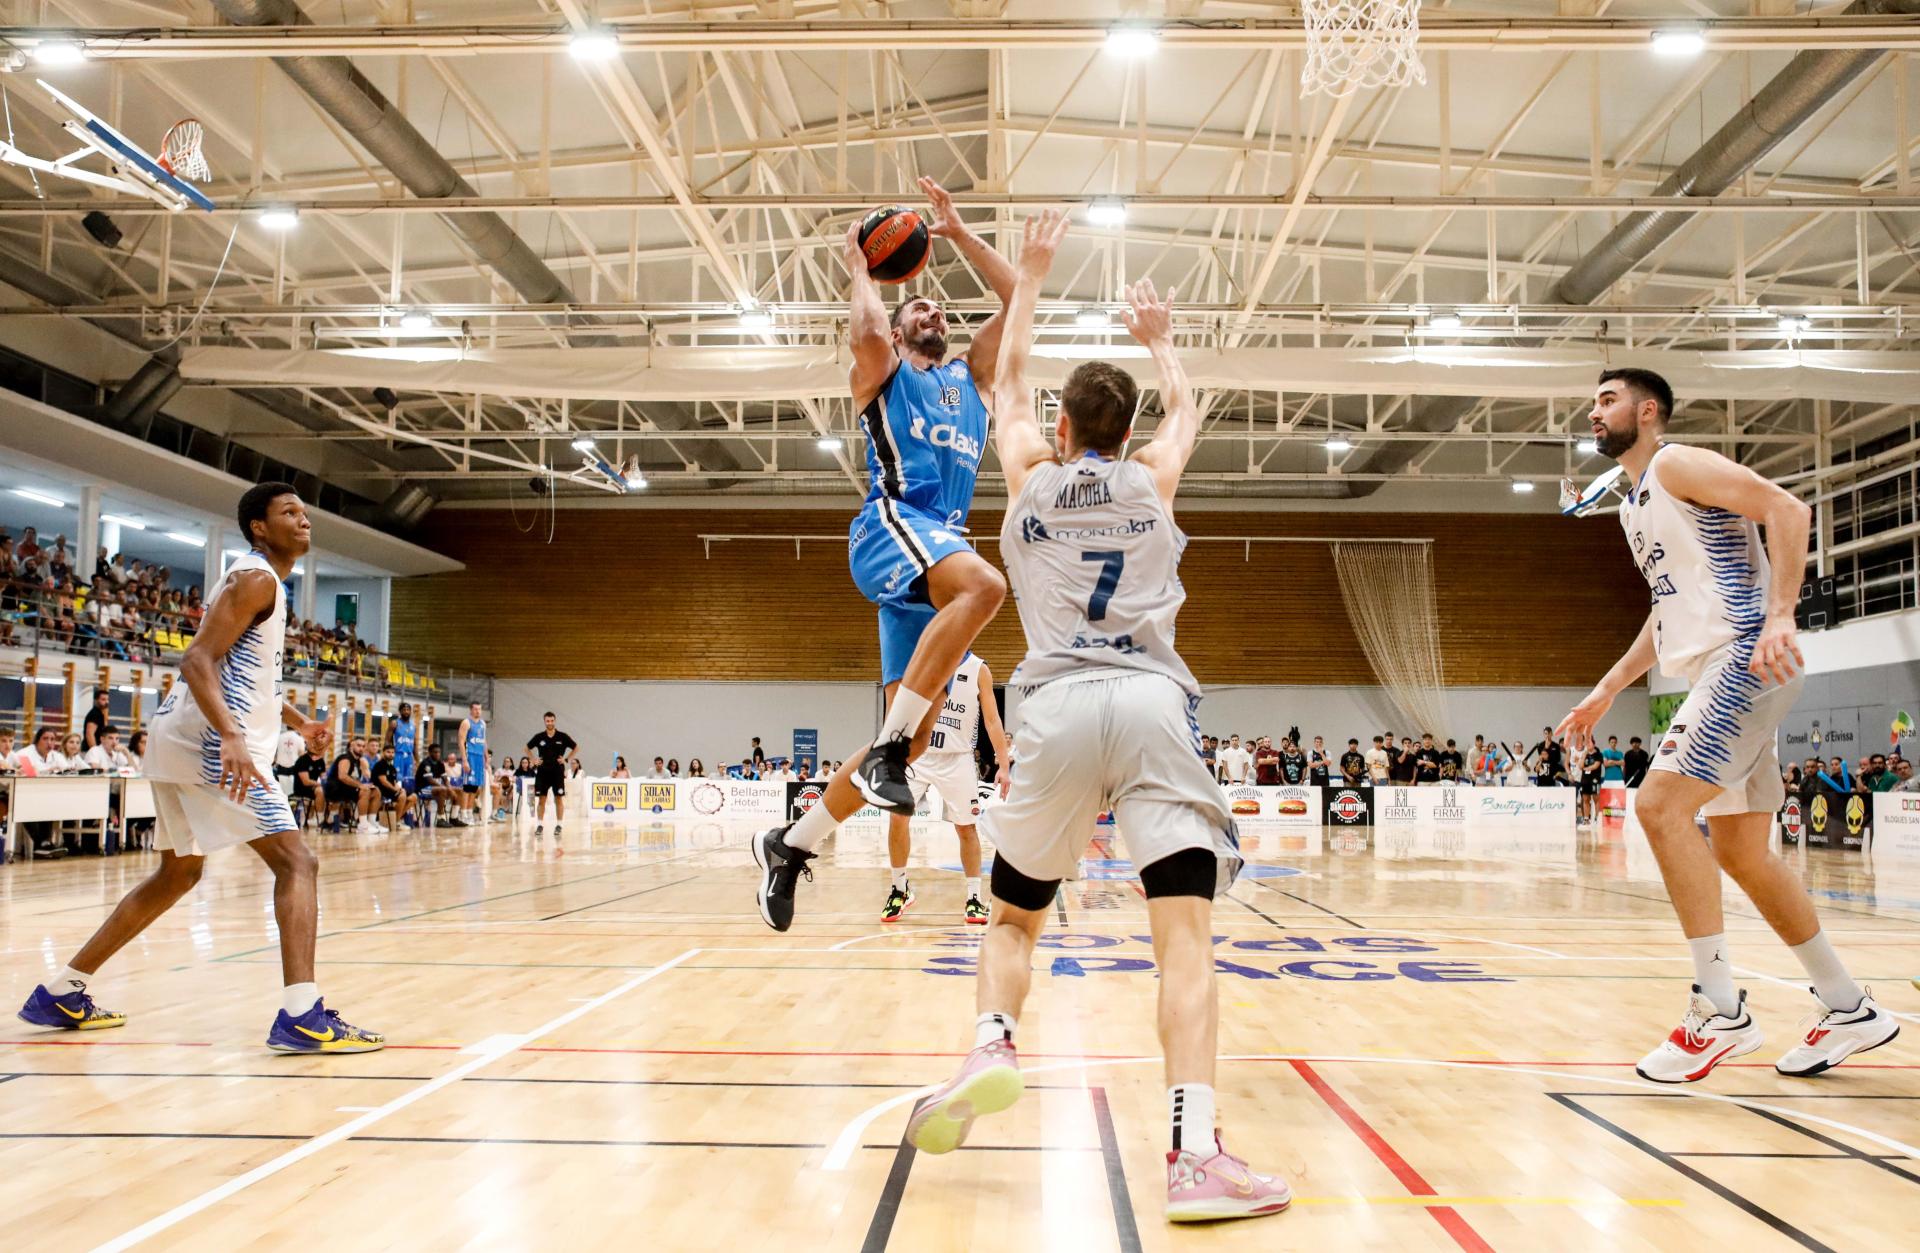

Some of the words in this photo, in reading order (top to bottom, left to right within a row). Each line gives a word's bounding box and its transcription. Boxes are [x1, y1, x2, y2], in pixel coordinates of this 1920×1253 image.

[938, 385, 961, 407] 12
[1081, 551, 1125, 621] 7
[1786, 732, 1808, 744] Consell
[596, 785, 623, 796] SOLAN
[644, 786, 671, 797] SOLAN
[731, 787, 782, 798] Bellamar
[734, 798, 759, 807] Hotel
[1481, 797, 1536, 816] Boutique
[1384, 808, 1417, 817] FIRME
[1433, 808, 1465, 817] FIRME
